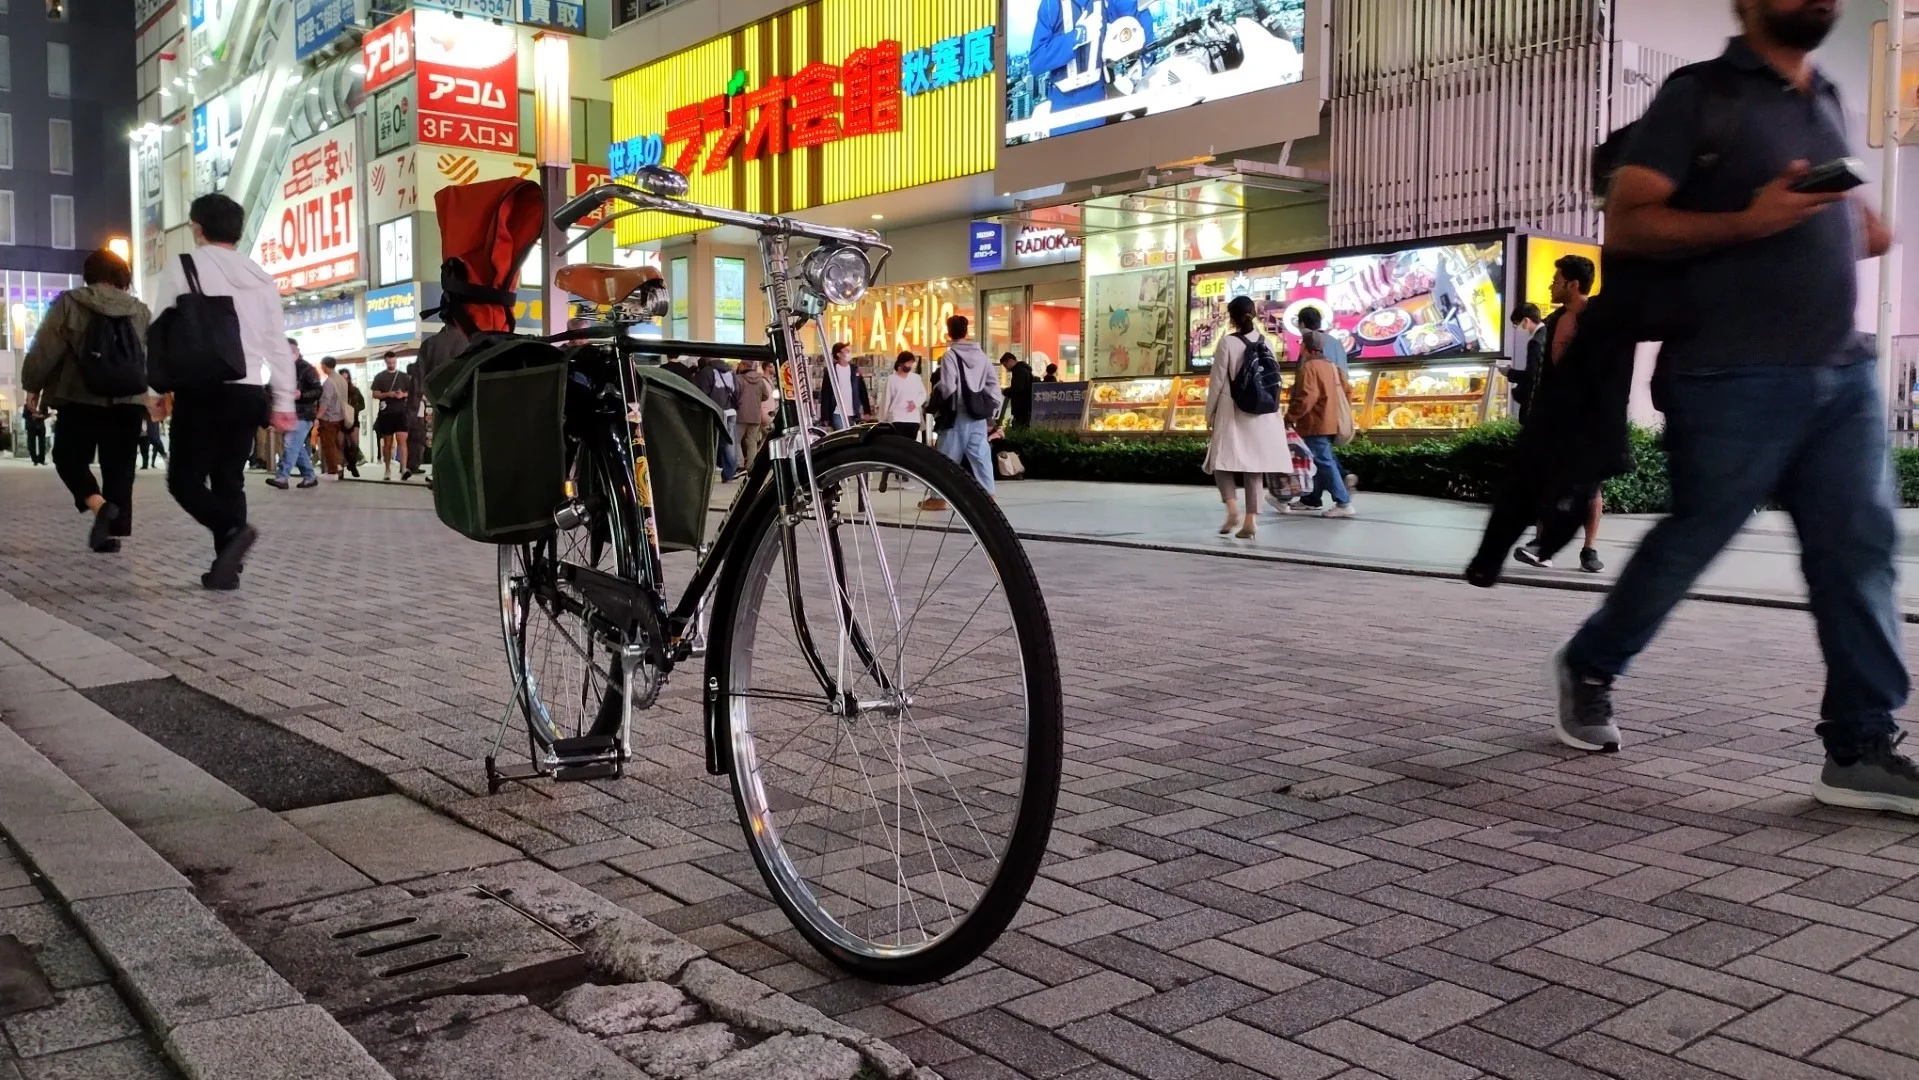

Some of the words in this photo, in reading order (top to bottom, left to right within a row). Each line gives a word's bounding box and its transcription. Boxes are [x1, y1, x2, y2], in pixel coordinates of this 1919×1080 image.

[529, 0, 579, 29] 買取
[365, 26, 409, 81] アコム
[428, 74, 507, 109] アコム
[608, 133, 662, 179] 世界の
[664, 40, 901, 177] ラジオ会館
[902, 25, 995, 97] 秋葉原
[423, 118, 453, 139] 3F
[458, 122, 496, 145] 入口
[281, 186, 353, 261] OUTLET
